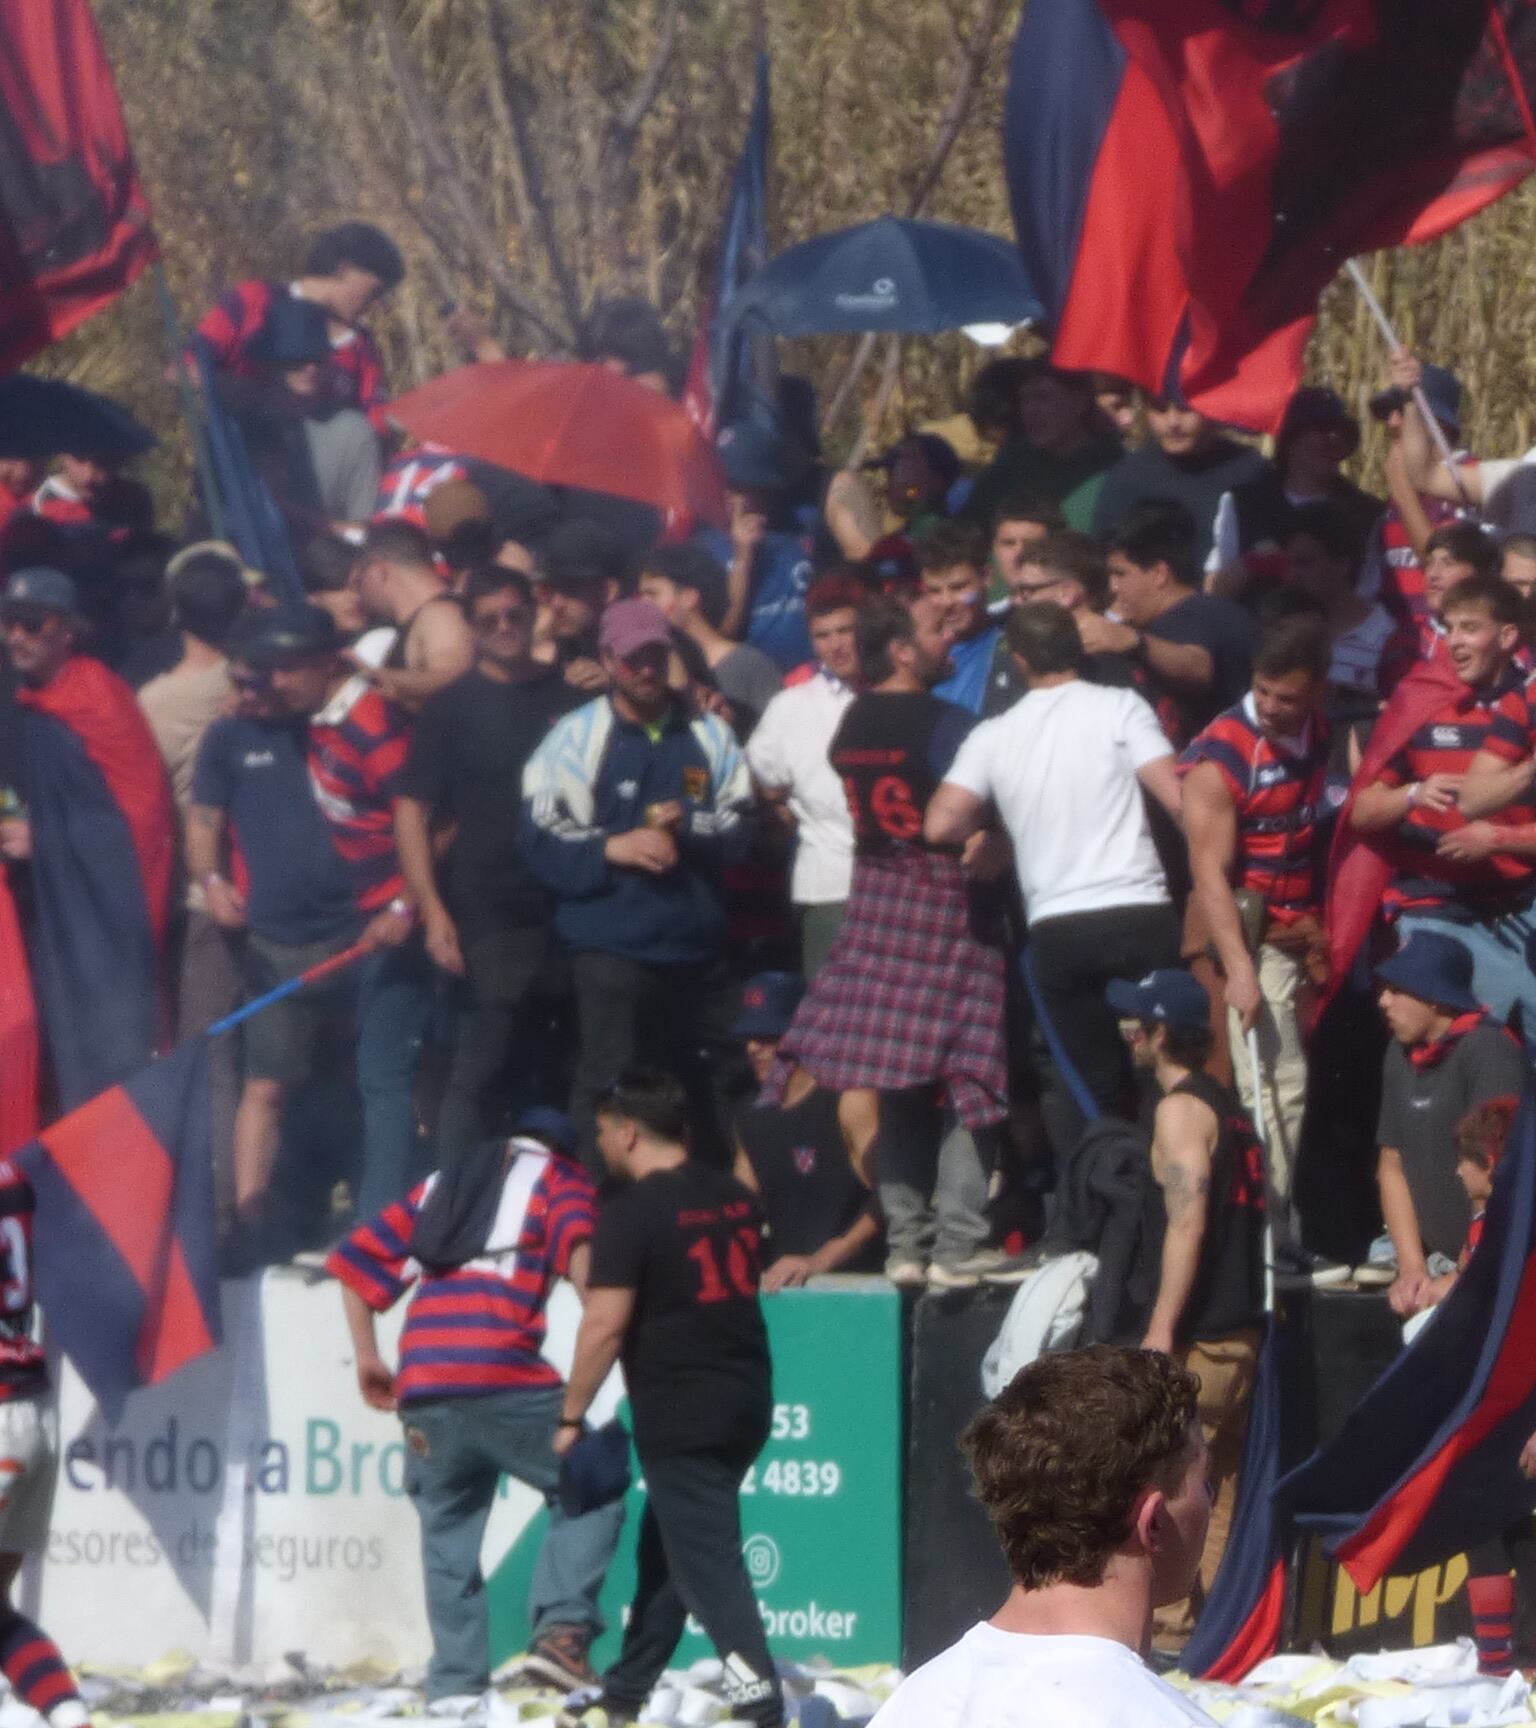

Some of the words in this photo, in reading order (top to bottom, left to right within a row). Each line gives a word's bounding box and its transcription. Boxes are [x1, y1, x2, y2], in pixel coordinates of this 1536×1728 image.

[63, 1412, 290, 1496] endoa
[762, 1460, 840, 1496] 4839
[244, 1531, 384, 1582] eguros
